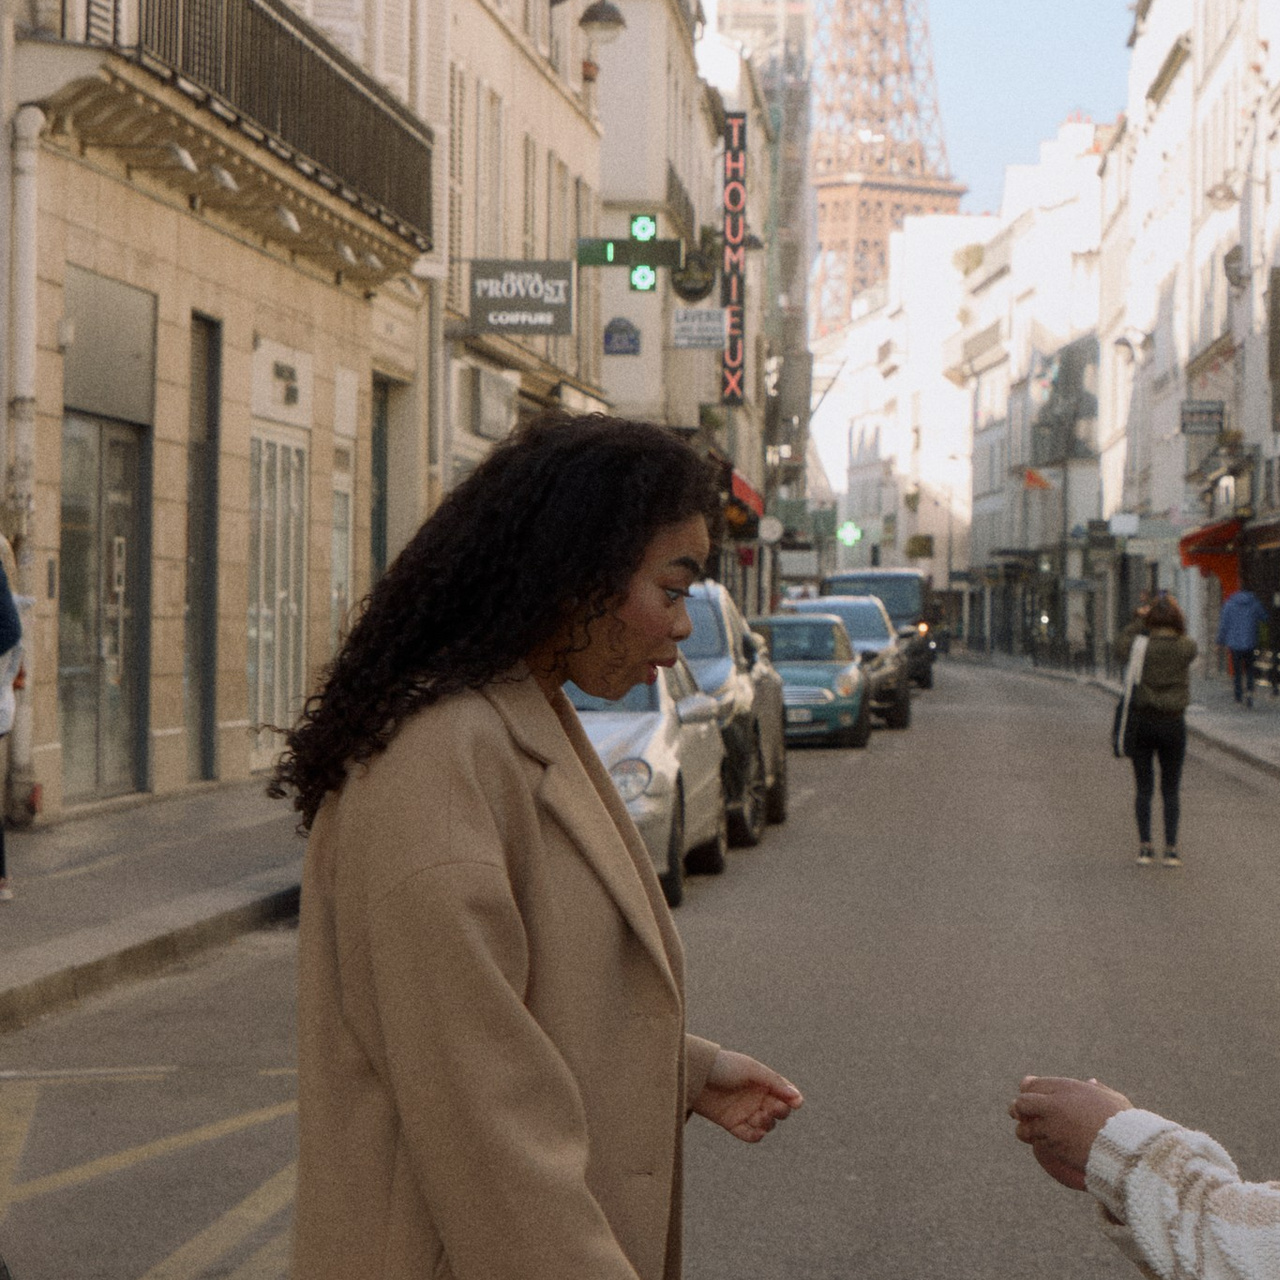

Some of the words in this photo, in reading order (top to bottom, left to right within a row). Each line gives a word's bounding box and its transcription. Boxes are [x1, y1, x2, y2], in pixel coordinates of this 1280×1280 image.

[723, 118, 746, 397] THOUMIEUX
[475, 279, 568, 299] PROVOST
[488, 311, 554, 326] COIFFURE
